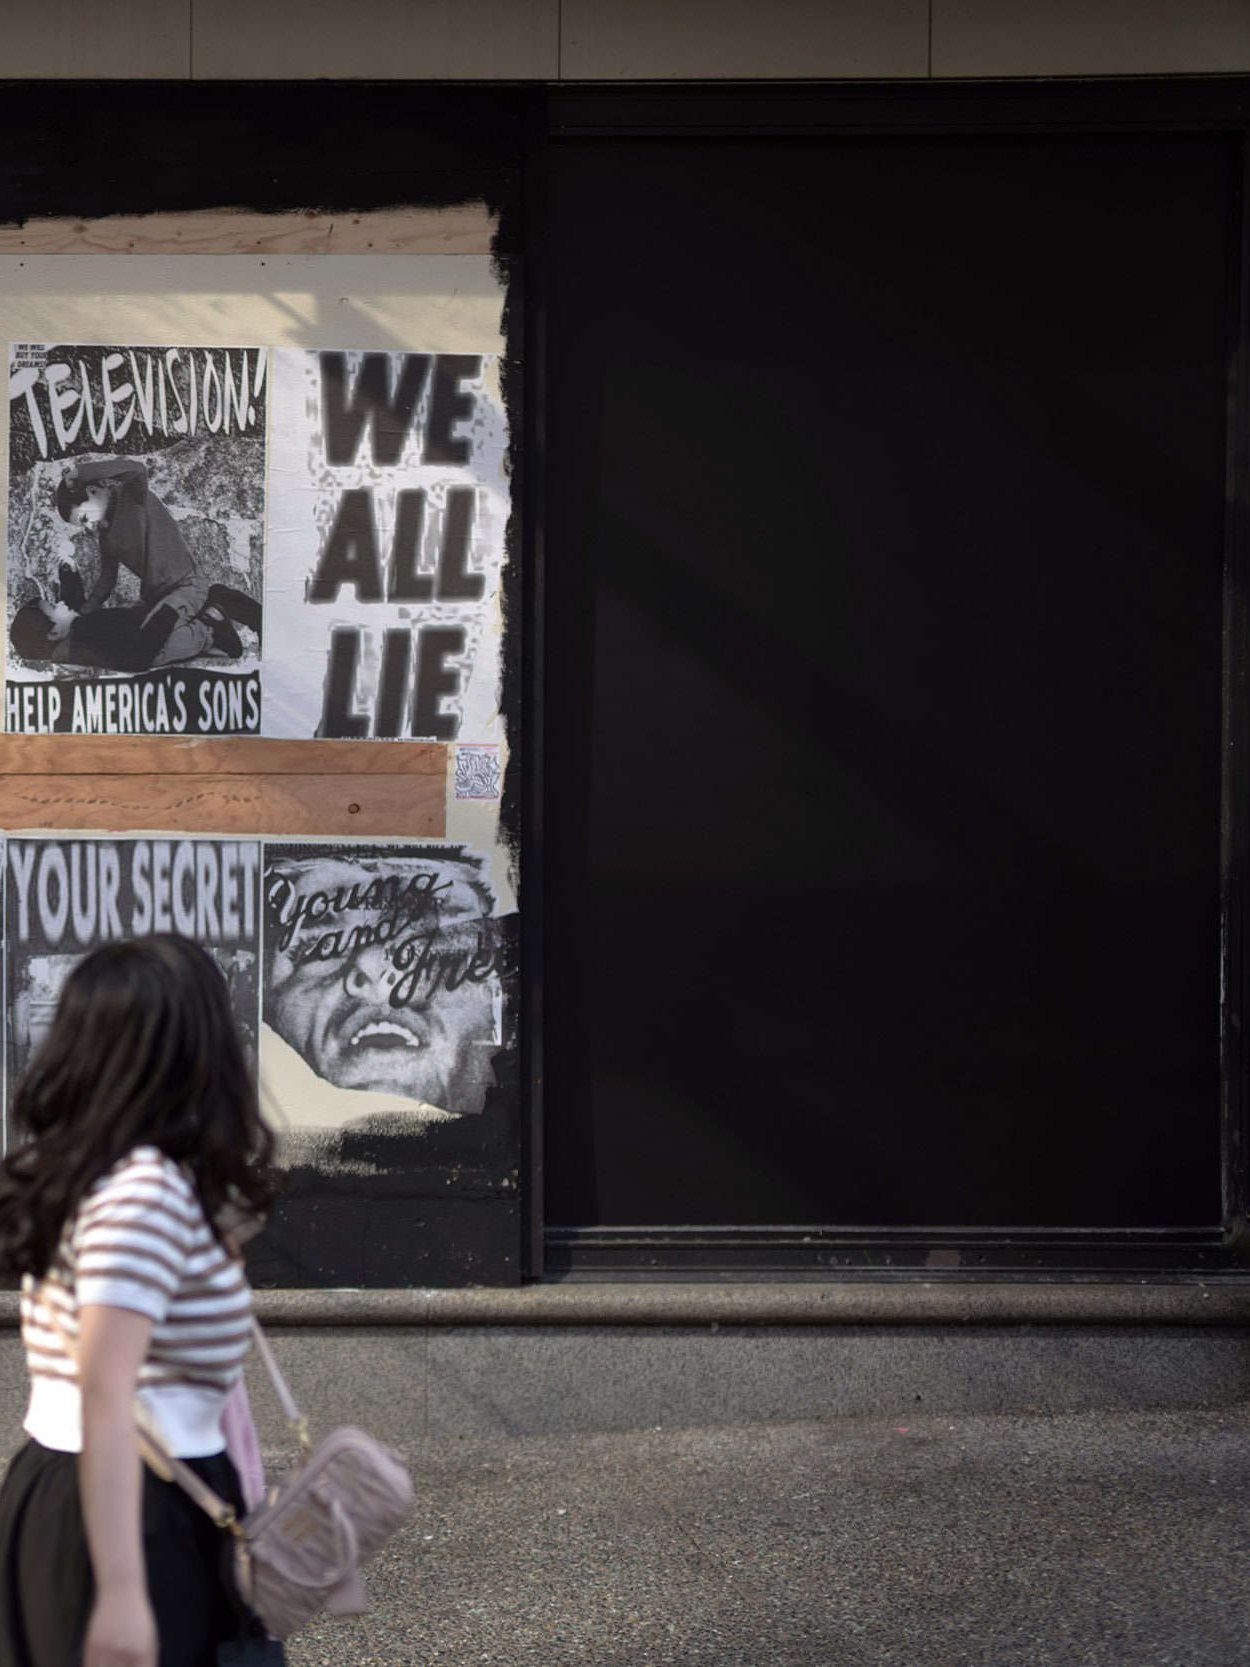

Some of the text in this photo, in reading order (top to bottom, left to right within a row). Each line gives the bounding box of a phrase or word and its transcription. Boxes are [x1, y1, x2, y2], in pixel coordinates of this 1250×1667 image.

[9, 348, 267, 459] TELEVISION!
[318, 350, 484, 467] WE
[307, 485, 487, 604] ALL
[6, 675, 260, 734] HELP AMERICA'S SONS
[314, 626, 469, 740] LIE
[8, 840, 259, 943] YOUR SECRET
[266, 872, 454, 952] Young
